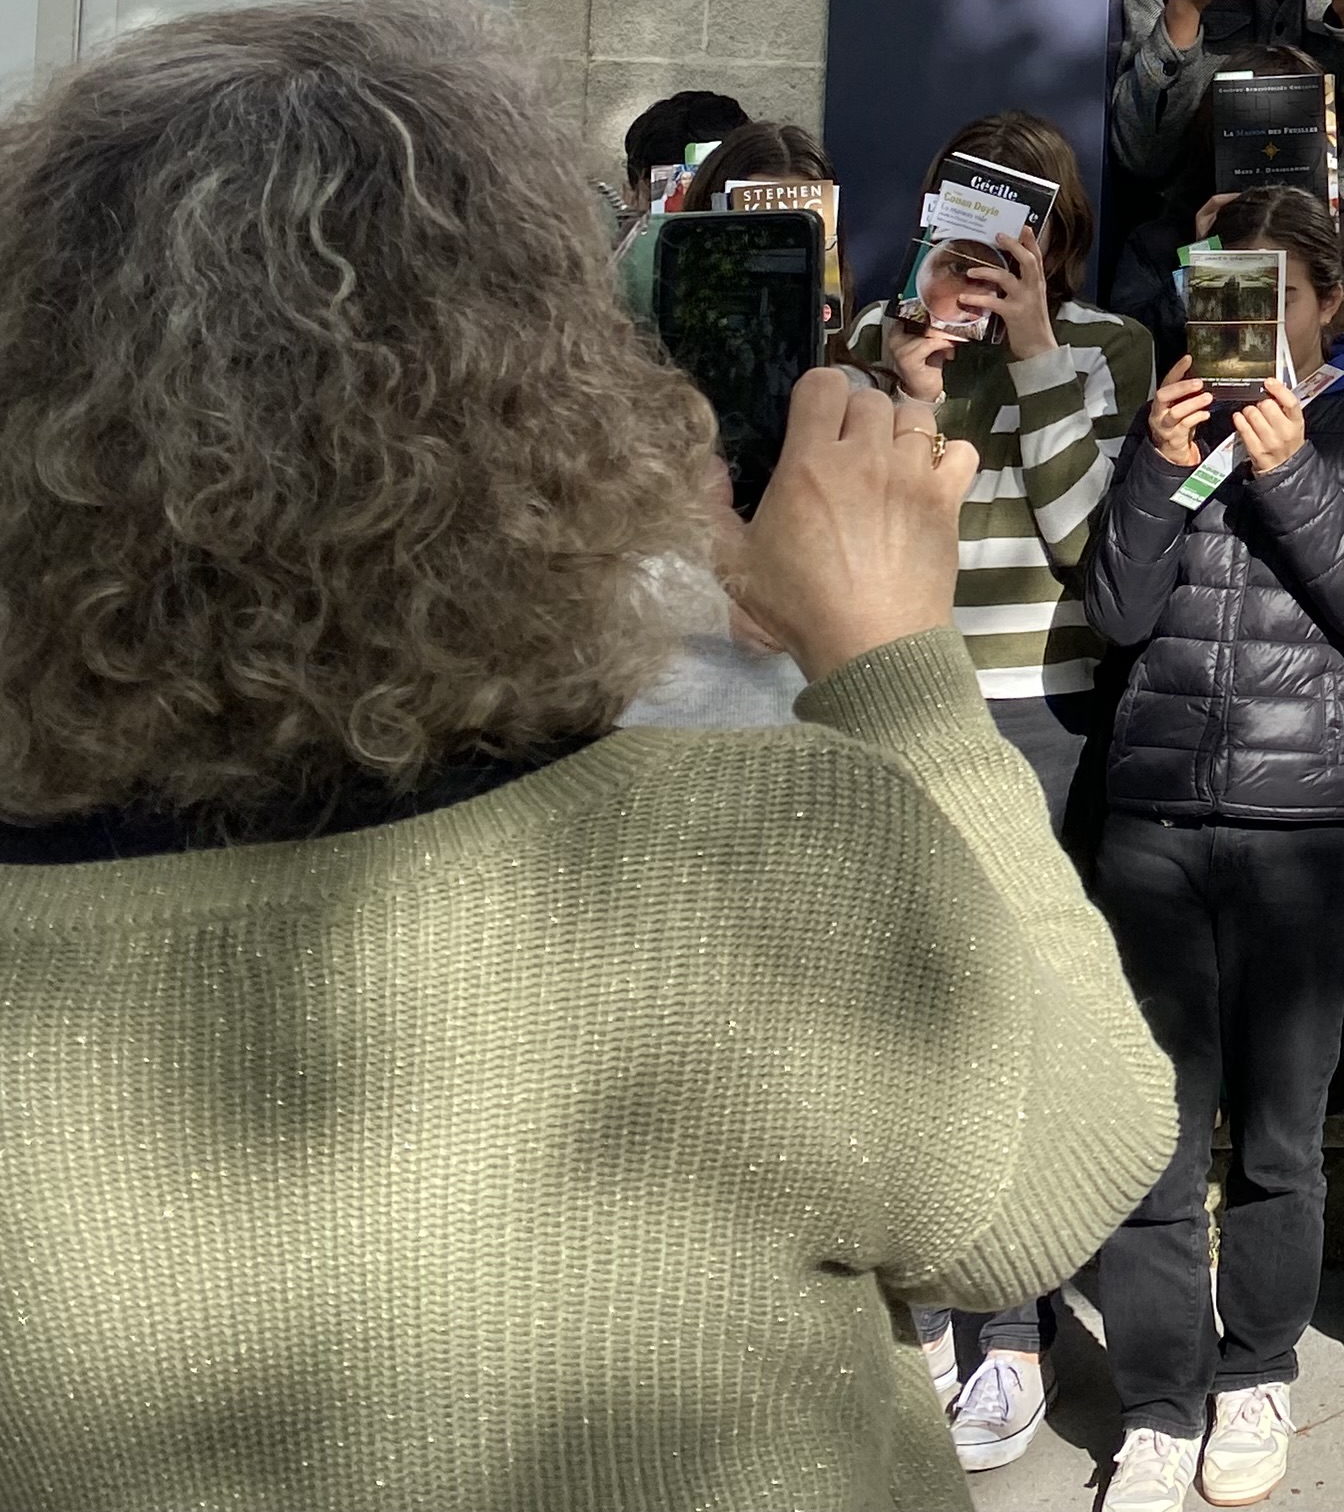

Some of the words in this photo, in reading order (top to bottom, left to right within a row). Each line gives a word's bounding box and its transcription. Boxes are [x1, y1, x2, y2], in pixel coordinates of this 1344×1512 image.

[743, 185, 822, 201] STEPHEN
[970, 176, 1018, 201] Cécile
[944, 192, 973, 207] Conan
[974, 201, 1000, 217] Doyle
